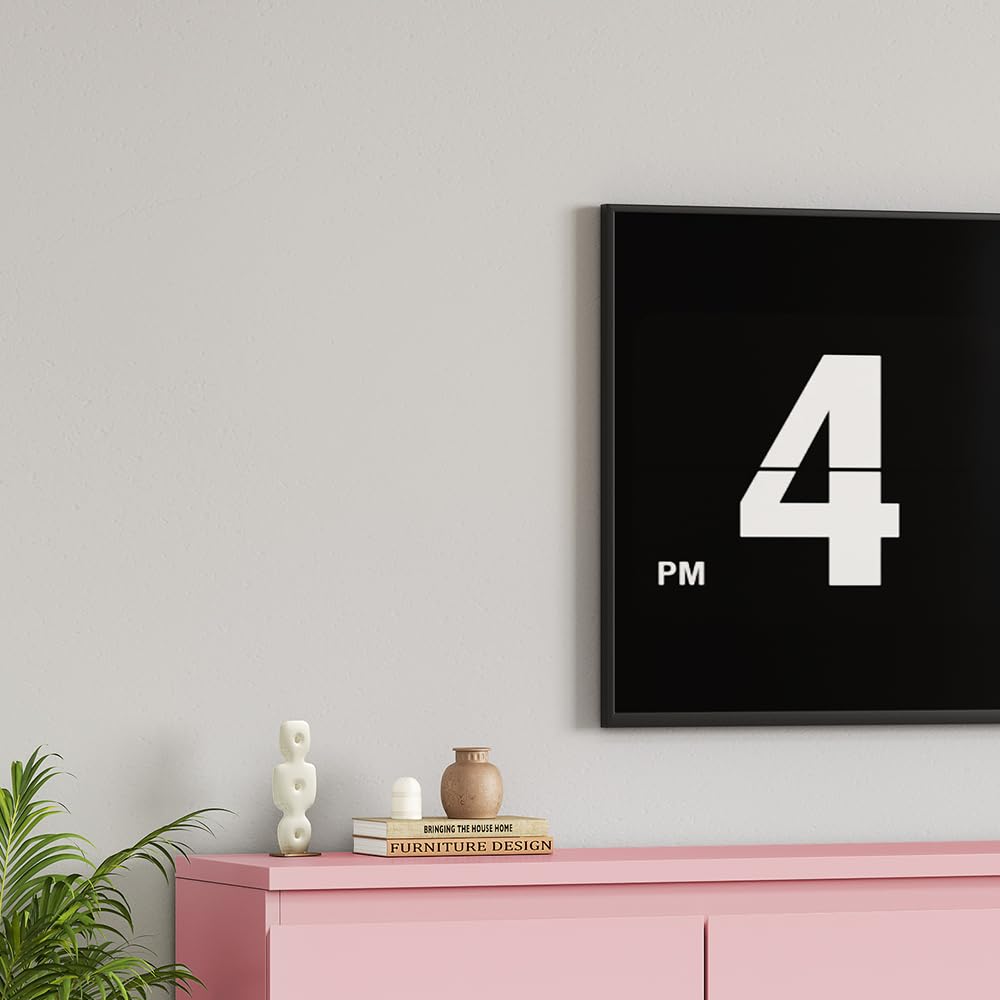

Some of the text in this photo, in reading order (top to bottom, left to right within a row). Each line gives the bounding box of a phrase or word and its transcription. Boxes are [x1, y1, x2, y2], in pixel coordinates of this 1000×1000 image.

[740, 354, 900, 587] 4
[657, 560, 706, 586] PM
[423, 823, 513, 834] BRINGING THE HOUSE HOME
[390, 840, 552, 854] FURNITURE DESIGN
